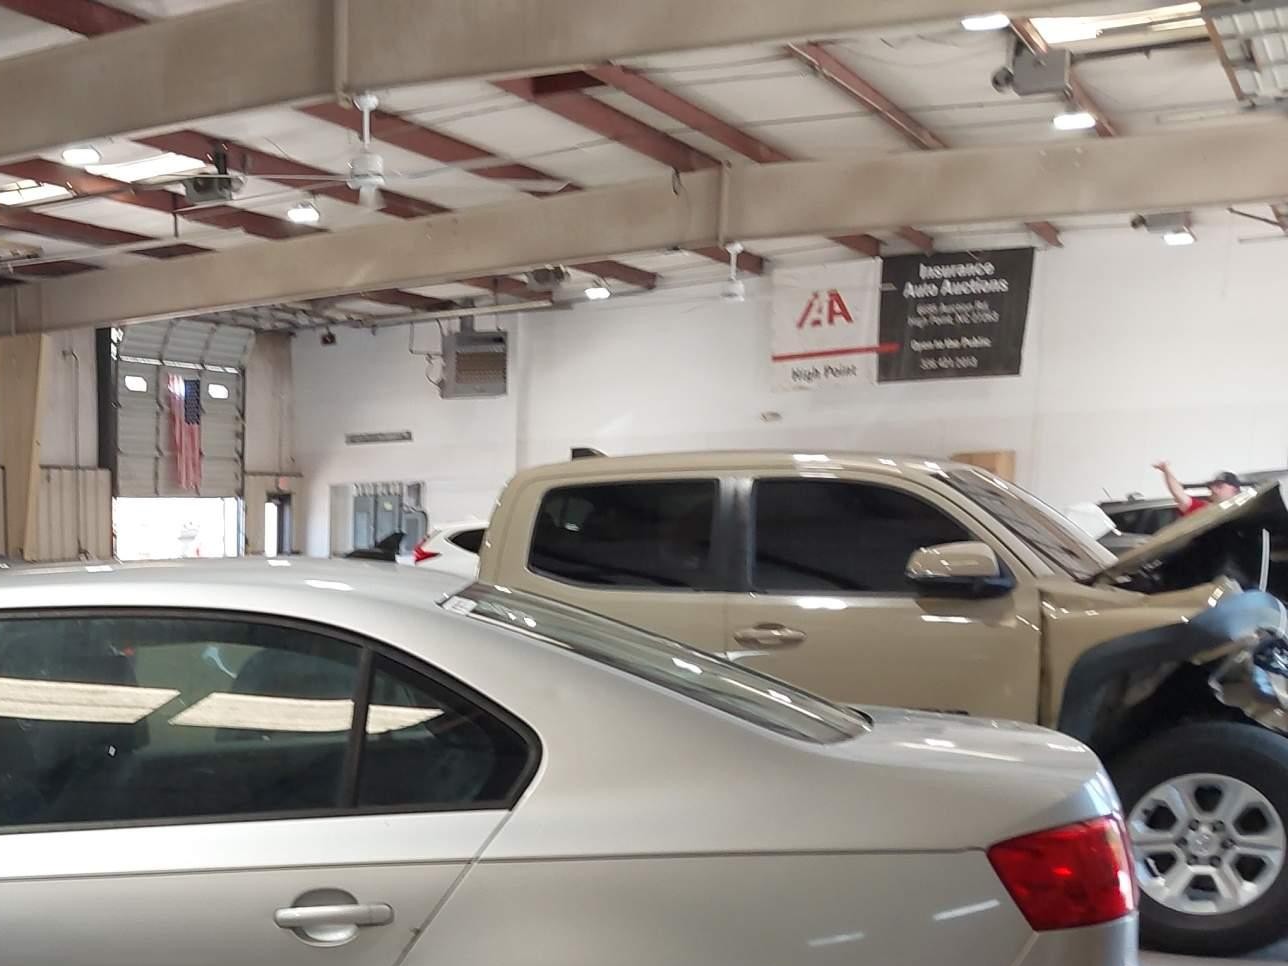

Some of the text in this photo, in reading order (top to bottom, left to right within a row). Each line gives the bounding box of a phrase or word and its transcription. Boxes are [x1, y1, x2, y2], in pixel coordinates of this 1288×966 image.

[919, 262, 995, 279] Insurance
[902, 277, 1009, 299] Auto Auctions
[792, 363, 858, 384] High Point
